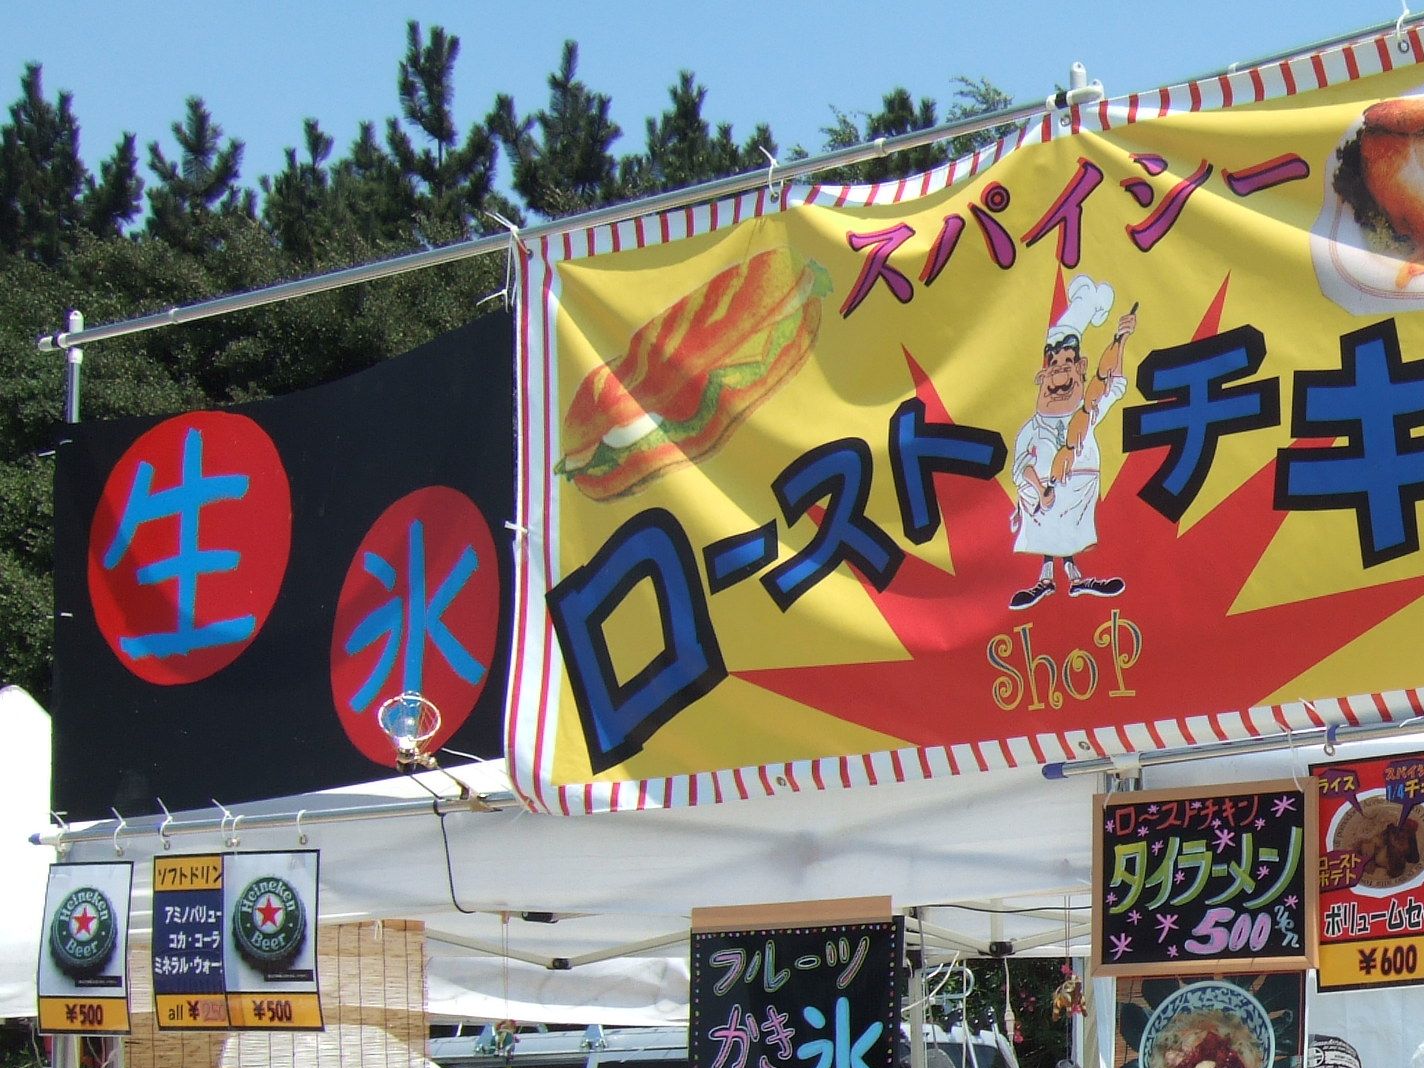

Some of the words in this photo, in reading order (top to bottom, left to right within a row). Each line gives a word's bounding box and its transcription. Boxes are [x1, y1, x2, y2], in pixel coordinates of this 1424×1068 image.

[841, 152, 1310, 318] スパイシー
[104, 427, 256, 661] 生
[344, 519, 487, 742] 氷
[1319, 776, 1355, 793] ライス
[1109, 826, 1303, 914] タイラーメン
[58, 890, 110, 923] Heineken
[240, 876, 297, 914] Heineken
[249, 932, 286, 951] Beer
[1185, 906, 1273, 954] 500
[65, 940, 99, 957] Beer
[1358, 944, 1418, 976] ¥600
[154, 955, 223, 975] ミネラル・ウォー
[709, 936, 870, 997] フルーツ
[65, 1003, 104, 1026] ¥500
[168, 1004, 184, 1021] all
[252, 1000, 293, 1023] ¥500
